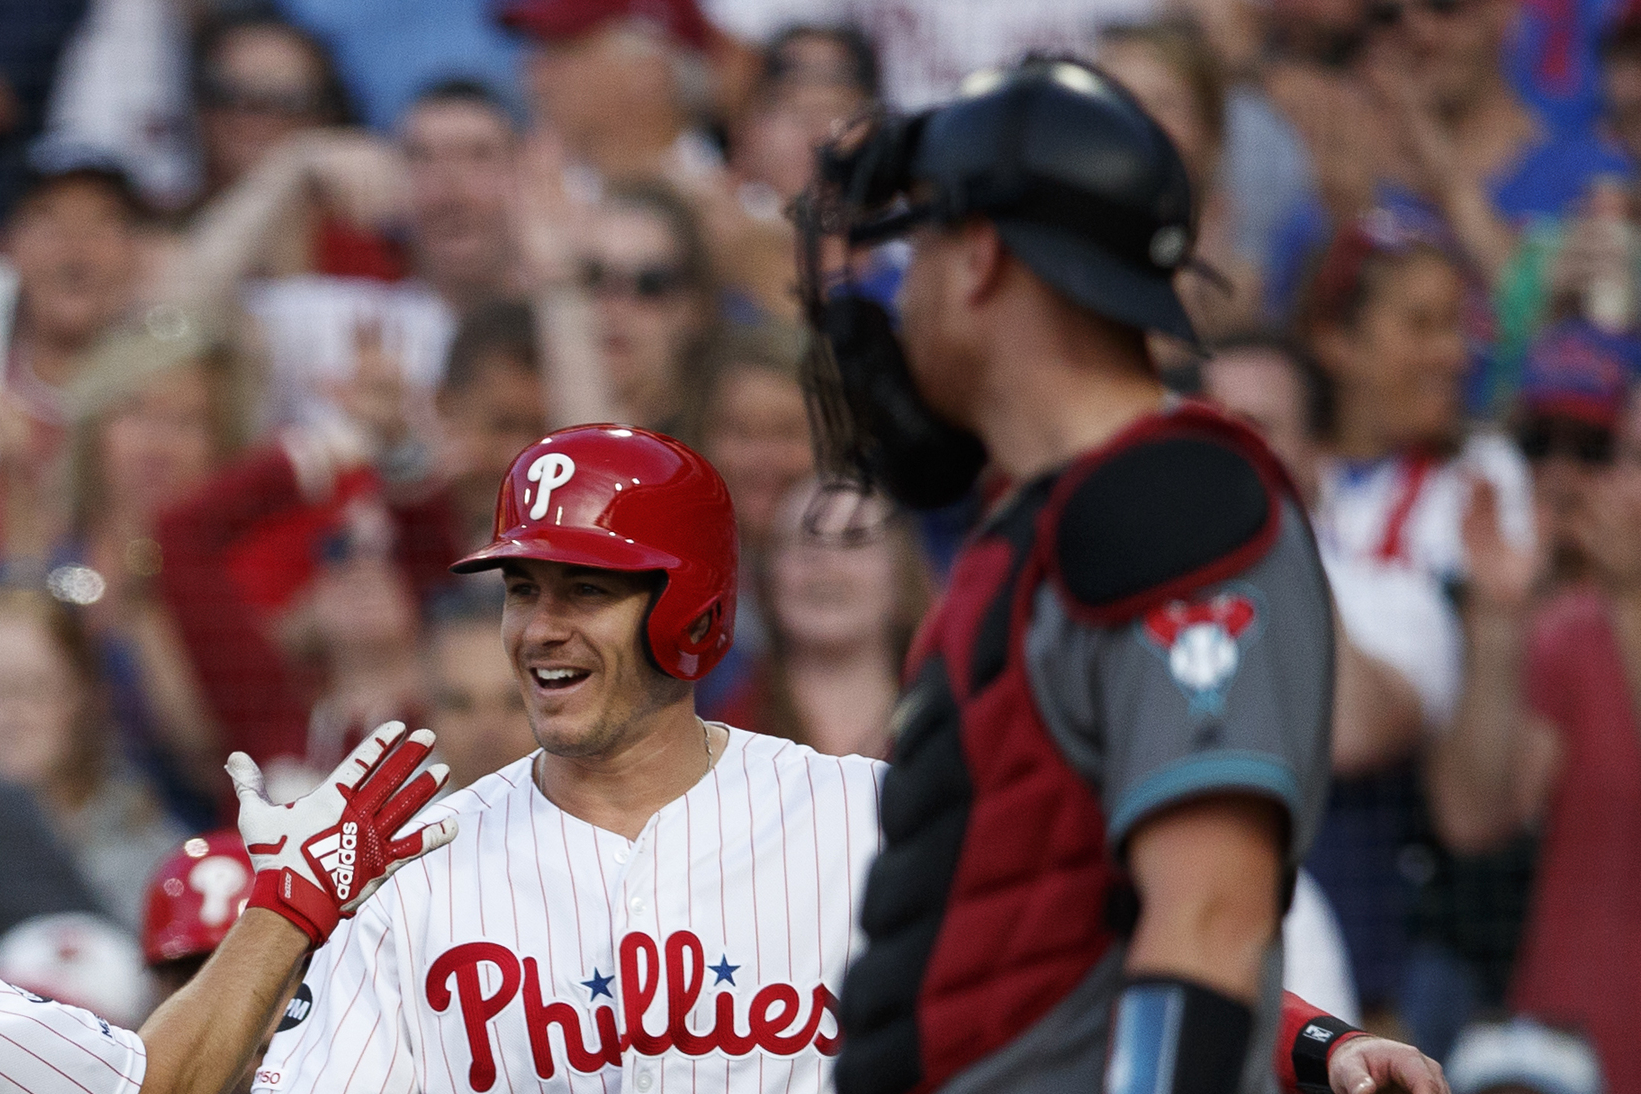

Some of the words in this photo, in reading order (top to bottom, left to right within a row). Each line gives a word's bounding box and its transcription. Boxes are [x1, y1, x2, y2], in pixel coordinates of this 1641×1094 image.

[526, 453, 575, 520] P
[337, 821, 358, 900] adidas
[425, 930, 845, 1093] Phillies
